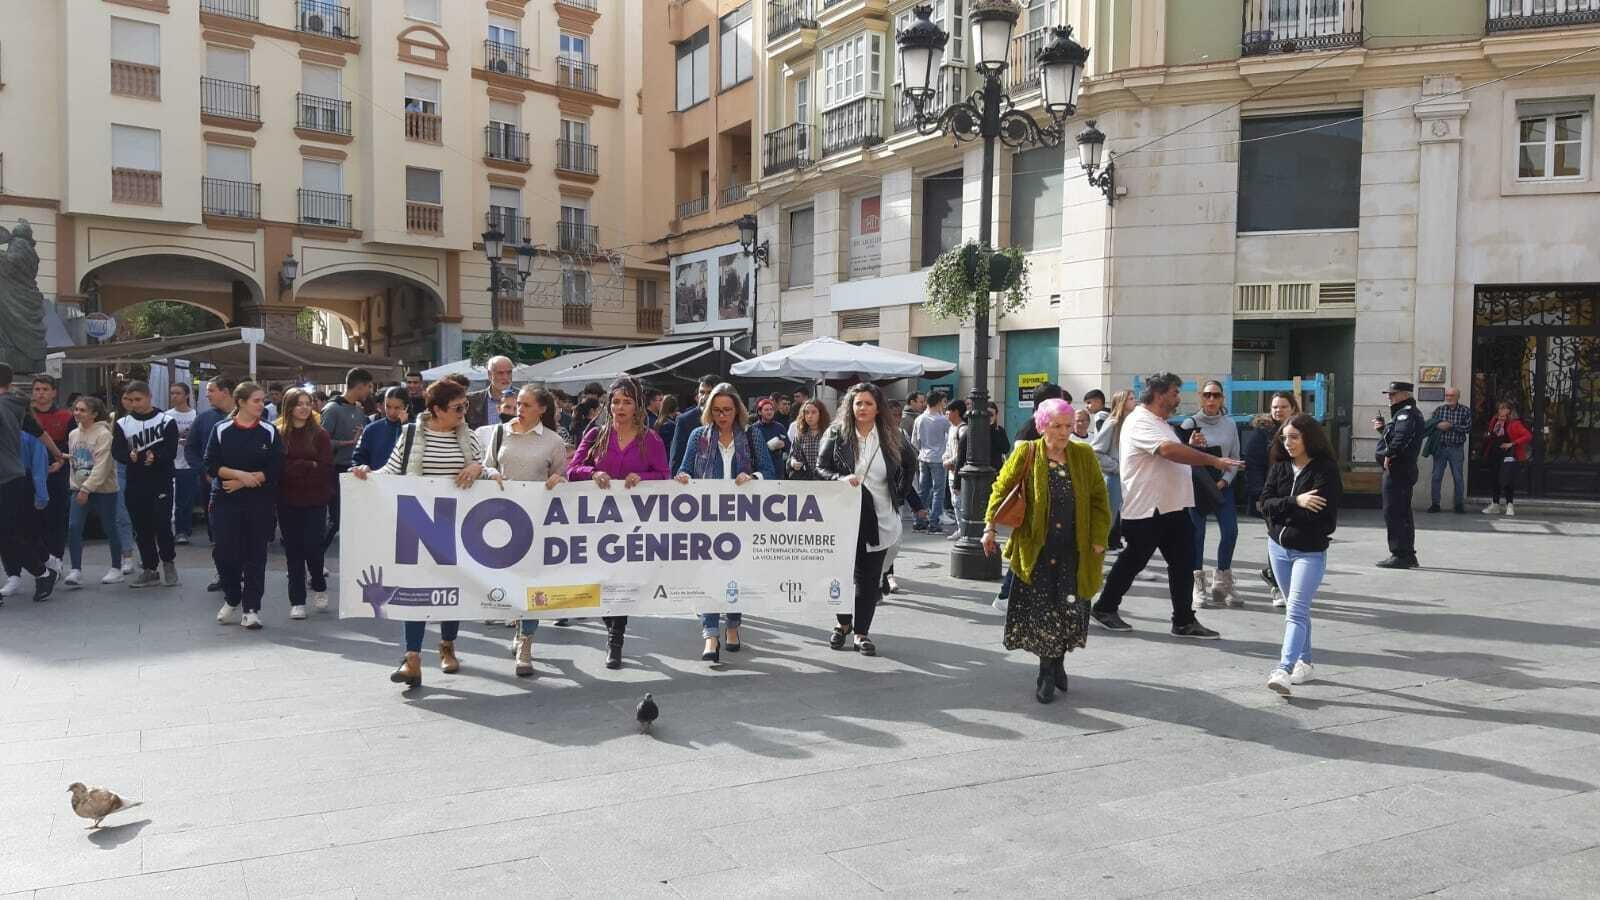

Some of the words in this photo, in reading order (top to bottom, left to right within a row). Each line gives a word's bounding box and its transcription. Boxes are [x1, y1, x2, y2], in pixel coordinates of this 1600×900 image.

[543, 497, 569, 526] A
[578, 495, 623, 524] LA
[630, 493, 824, 523] VIOLENCIA
[395, 494, 534, 569] NO
[543, 535, 588, 565] DE
[597, 526, 742, 564] GÉNERO
[752, 533, 767, 546] 25
[770, 534, 836, 547] NOVIEMBRE
[431, 589, 458, 605] 016
